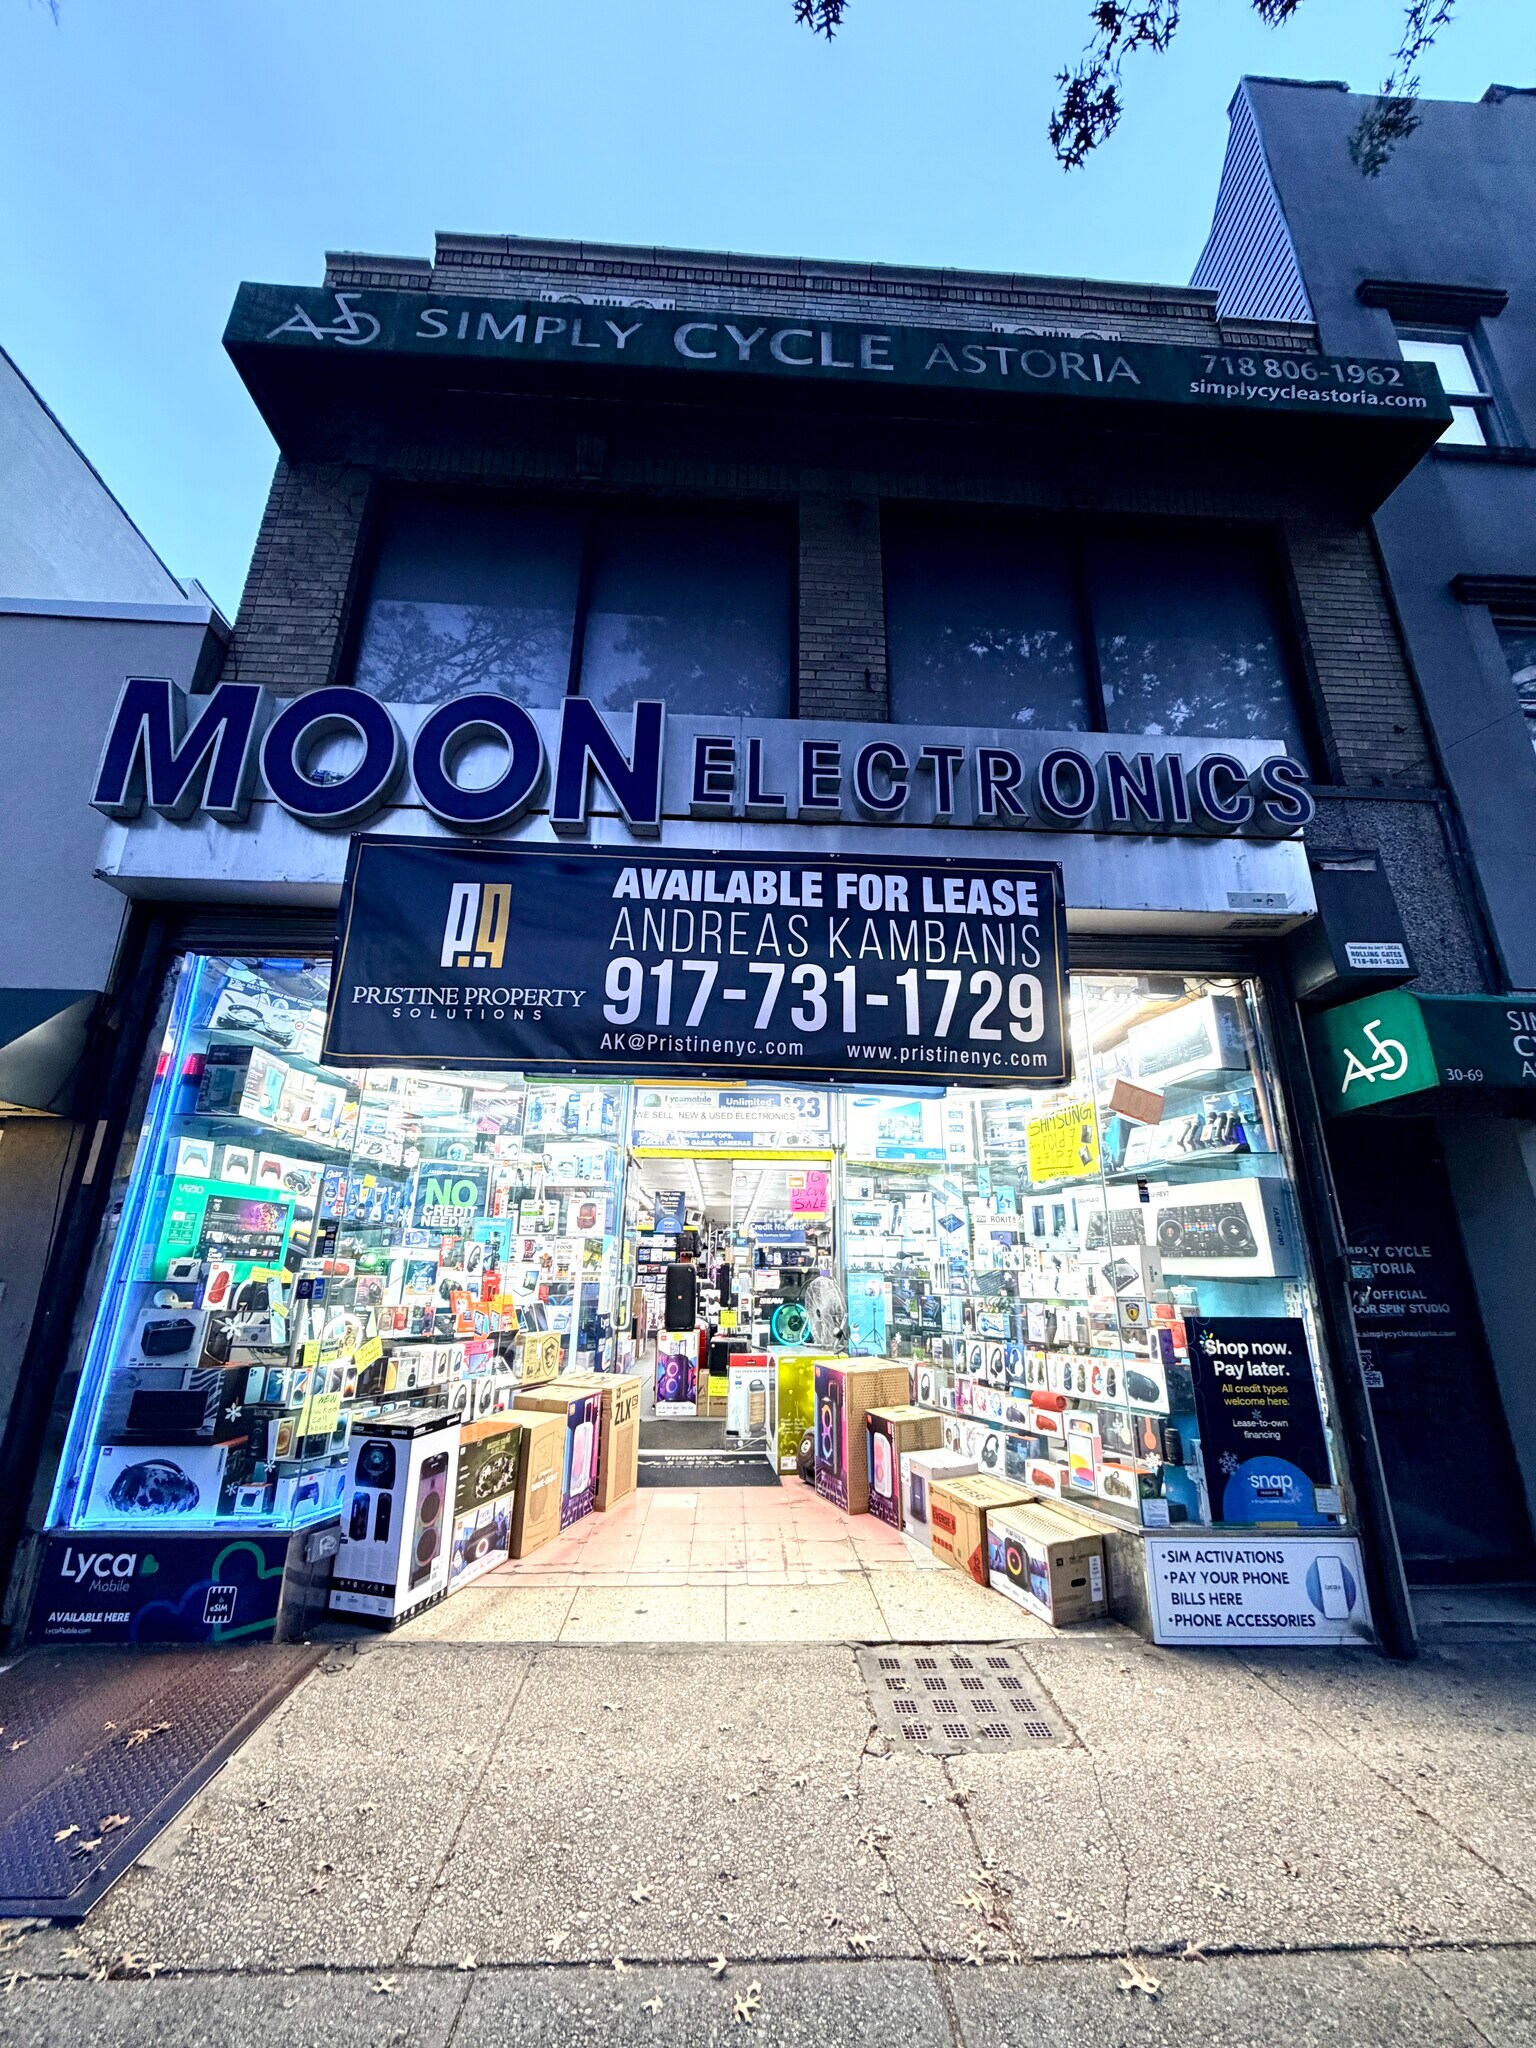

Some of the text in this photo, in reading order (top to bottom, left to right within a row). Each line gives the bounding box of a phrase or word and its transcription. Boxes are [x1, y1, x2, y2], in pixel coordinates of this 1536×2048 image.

[415, 307, 1141, 386] SIMPLY CYCLE ASTORIA
[1203, 353, 1406, 387] 718 806-1962
[1189, 380, 1428, 410] simplycycleastoria.com
[90, 676, 1315, 834] MOON ELECTRONICS
[612, 866, 1039, 917] AVAILABLE FOR LEASE
[609, 906, 1041, 968] ANDREAS KAMBANIS
[351, 986, 587, 1008] PRISTINE PROPERTY
[602, 956, 1045, 1043] 917-731-1729
[392, 1007, 543, 1021] SOLUTIONS
[600, 1033, 804, 1056] AK@Pristinenyc.com
[846, 1043, 1048, 1067] www.pristinenyc.com
[1446, 1068, 1484, 1082] 30-69
[652, 1111, 673, 1119] SELL
[678, 1111, 699, 1119] NEW
[709, 1112, 734, 1120] USED
[735, 1112, 796, 1120] ELECTRONICS
[1029, 1104, 1092, 1137] SAMSUNG
[806, 1171, 821, 1183] IG
[179, 1184, 204, 1194] VIZIO
[424, 1178, 478, 1207] NO
[422, 1204, 478, 1217] CREDIT
[795, 1198, 827, 1210] SALE
[990, 1215, 1012, 1223] ROKIT
[1385, 1246, 1432, 1258] CYCLE
[1372, 1290, 1428, 1300] OFFICIAL
[1409, 1304, 1451, 1314] STUDIO
[1204, 1339, 1292, 1358] Shop now.
[1213, 1360, 1290, 1380] Pay later.
[1221, 1383, 1288, 1396] All credit types
[1224, 1396, 1290, 1406] welcome here.
[614, 1397, 632, 1426] ZLX
[1232, 1418, 1289, 1428] Lease-to-own
[1244, 1430, 1281, 1441] financing
[1250, 1474, 1293, 1493] snap
[1167, 1550, 1285, 1564] SIM ACTIVATIONS
[61, 1547, 137, 1583] Lyca
[1170, 1571, 1290, 1585] PAY YOUR PHONE
[88, 1579, 130, 1593] Mobile
[1171, 1592, 1243, 1606] BILLS HERE
[209, 1603, 228, 1612] eSIM
[47, 1611, 131, 1623] AVAILABLE HERE
[1174, 1613, 1316, 1627] PHONE ACCESSORIES
